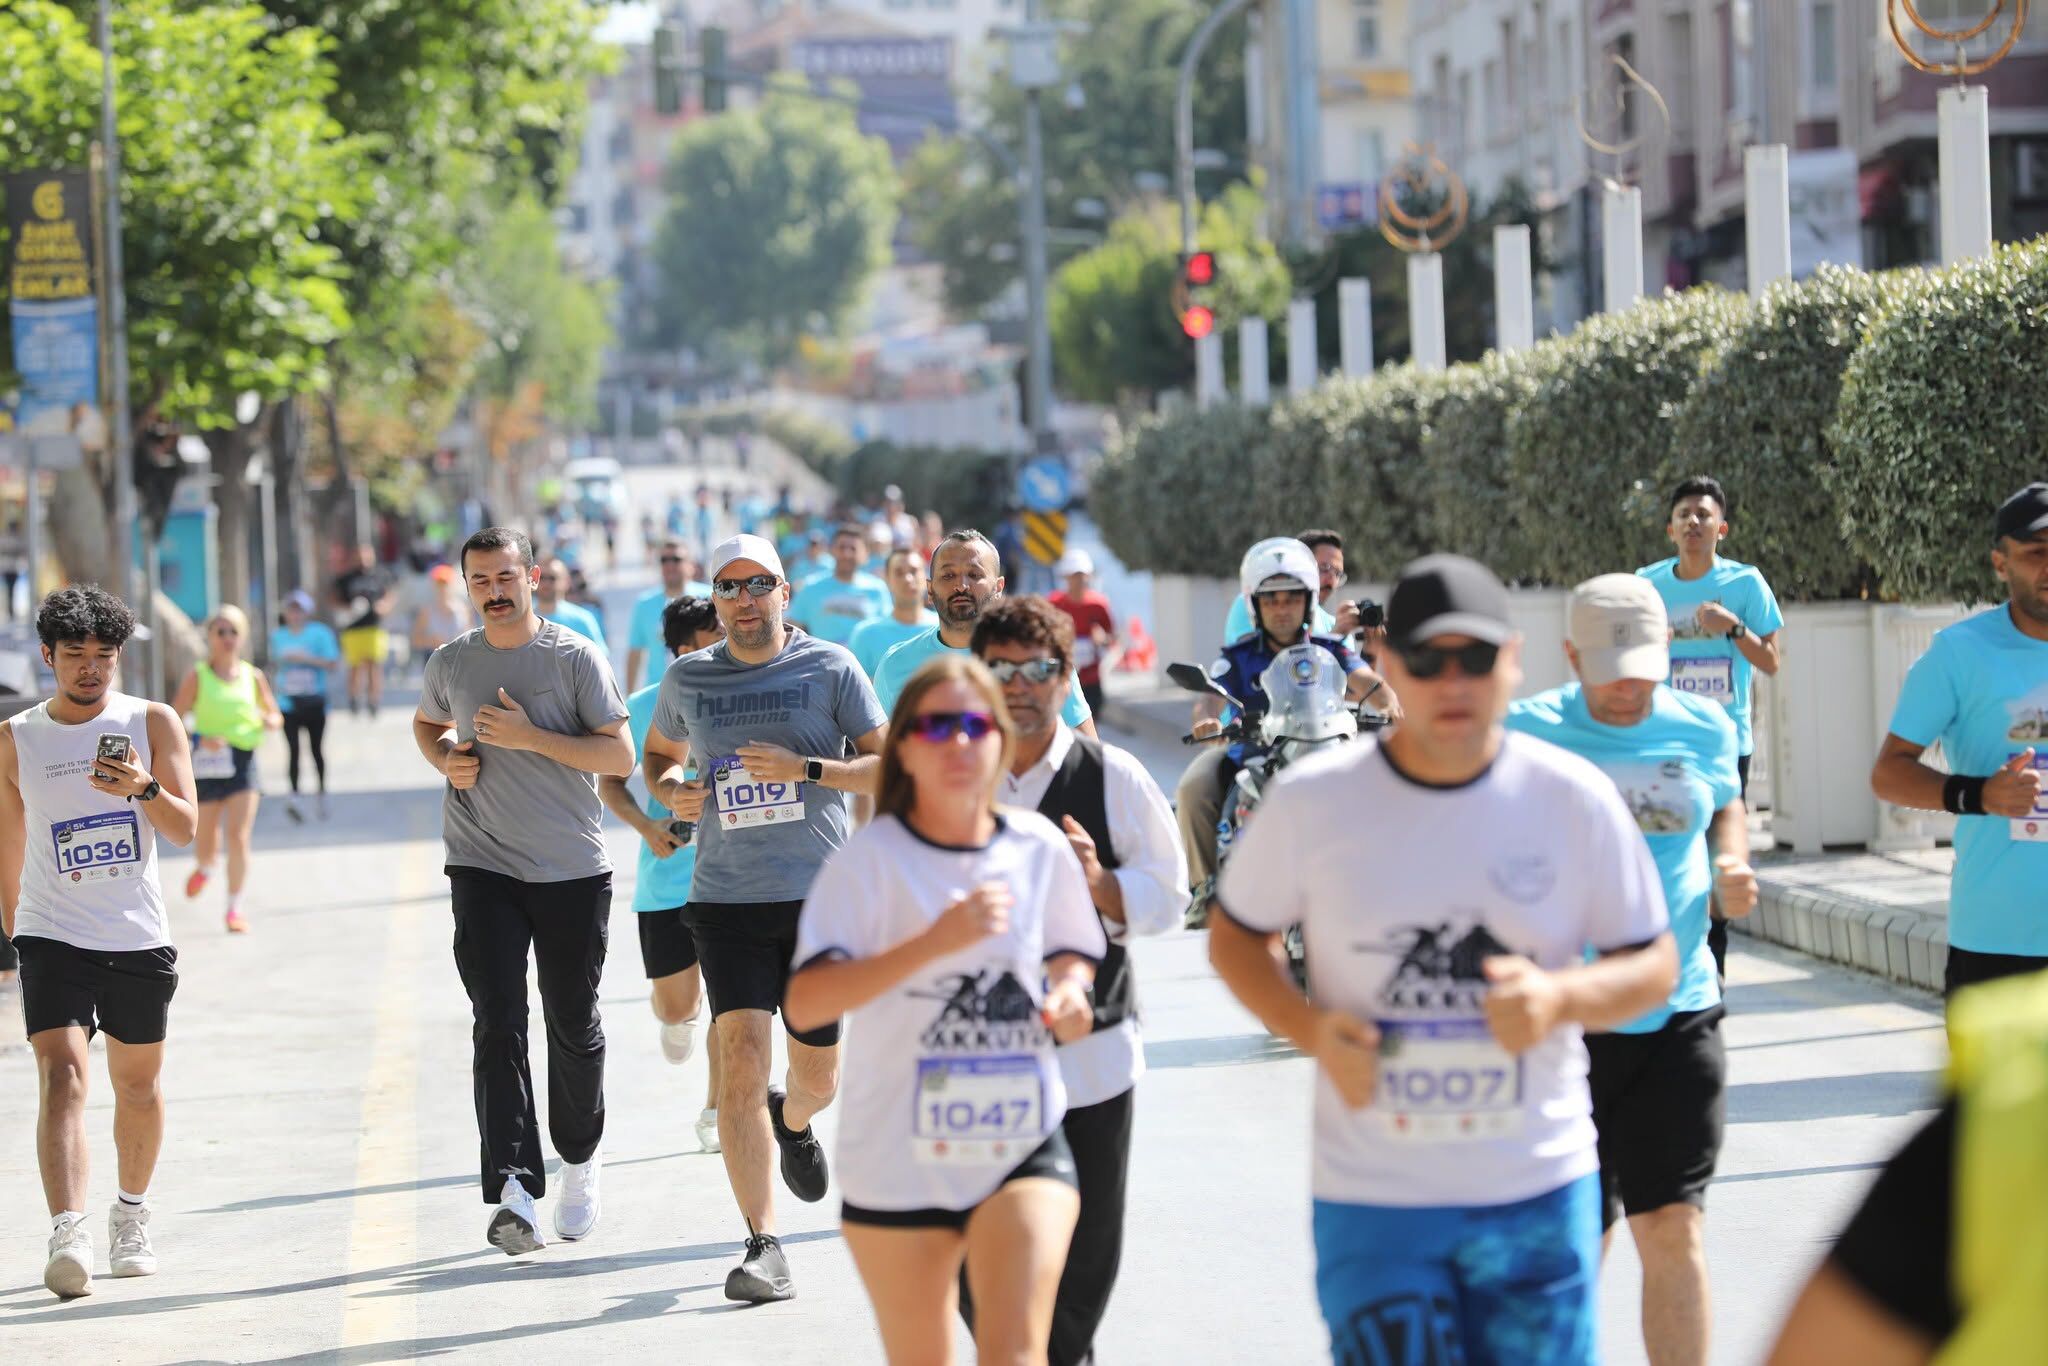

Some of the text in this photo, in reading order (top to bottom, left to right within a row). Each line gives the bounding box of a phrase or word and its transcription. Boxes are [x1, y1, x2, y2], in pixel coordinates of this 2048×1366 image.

[1676, 677, 1725, 692] 1035
[697, 682, 810, 719] hummel
[712, 710, 791, 728] RUNNING
[45, 763, 66, 771] TODAY
[50, 768, 80, 778] CREATED
[724, 782, 786, 807] 1019
[73, 822, 86, 830] 5K
[62, 839, 131, 867] 1036
[1385, 1066, 1505, 1104] 1007
[930, 1100, 1030, 1131] 1047
